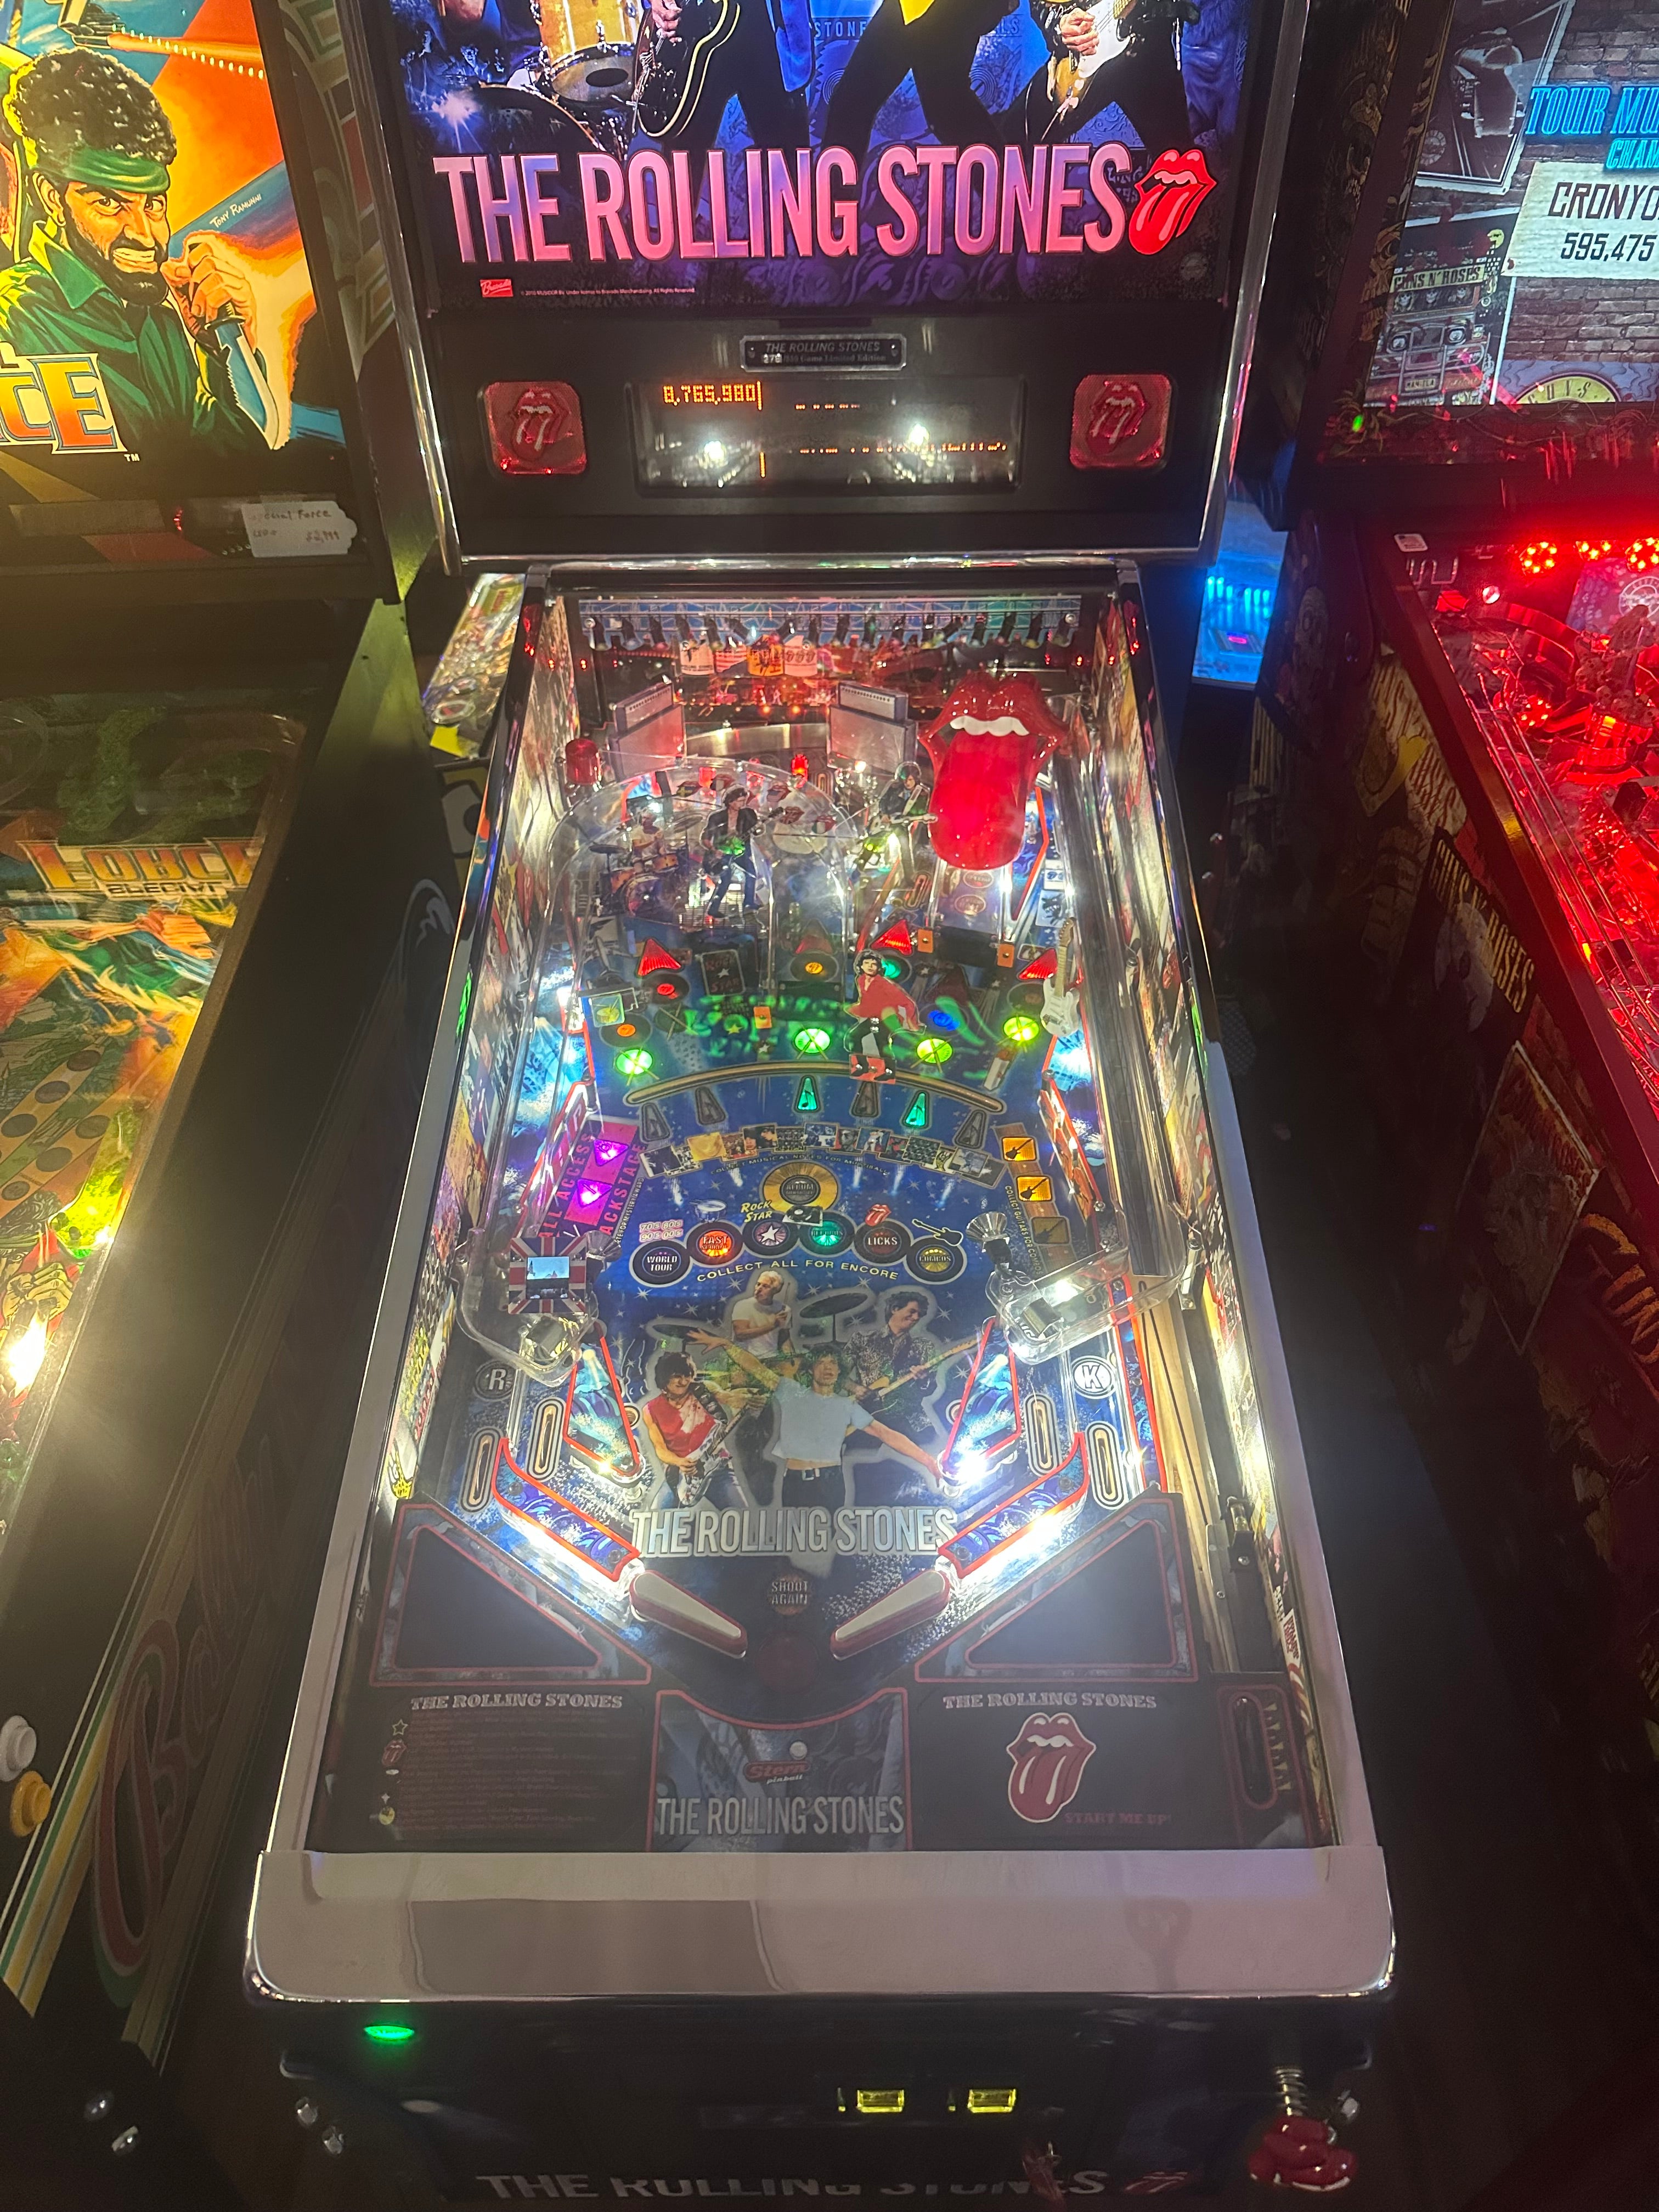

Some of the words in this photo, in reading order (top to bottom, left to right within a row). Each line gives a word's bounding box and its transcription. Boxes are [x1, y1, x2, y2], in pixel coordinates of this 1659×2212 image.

[1526, 86, 1611, 135] TOUR
[432, 155, 572, 263] THE
[578, 148, 860, 262] ROLLING
[876, 143, 1131, 256] STONES
[209, 210, 229, 228] TONY
[1560, 232, 1658, 262] 595,475
[1442, 267, 1481, 285] ROSES
[766, 342, 786, 353] THE
[789, 342, 835, 352] ROLLING
[838, 341, 881, 352] STONES
[124, 453, 140, 462] TM
[556, 1132, 593, 1201] ACCESS
[599, 1144, 647, 1236] ACKSTAGE
[741, 1200, 772, 1214] ROCK
[1005, 1184, 1019, 1210] COLLECT
[1014, 1211, 1029, 1235] GUITARS
[1023, 1237, 1033, 1248] FOR
[744, 1210, 773, 1223] STAR
[703, 1235, 729, 1244] FAST
[867, 1236, 898, 1246] LICKS
[646, 1255, 678, 1264] WORLD
[651, 1263, 673, 1272] TOUR
[697, 1261, 763, 1282] COLLECT
[770, 1260, 799, 1268] ALL
[805, 1260, 834, 1268] FOR
[840, 1262, 899, 1280] ENCORE
[487, 1368, 506, 1391] R
[1083, 1363, 1102, 1391] K
[632, 1510, 690, 1554] THE
[697, 1508, 827, 1553] ROLLING
[836, 1508, 956, 1553] STONES
[771, 1580, 809, 1593] SHOOT
[771, 1593, 809, 1605] AGAIN
[410, 1695, 449, 1710] THE
[452, 1693, 541, 1708] ROLLING
[545, 1694, 623, 1709] STONES
[943, 1695, 983, 1709] THE
[988, 1692, 1078, 1707] ROLLING
[1081, 1692, 1157, 1708] STONES
[746, 1761, 809, 1779] Stern
[766, 1773, 804, 1785] pinball
[657, 1797, 701, 1835] THE
[707, 1796, 807, 1835] ROLLING
[813, 1795, 905, 1835] STONES
[1063, 1812, 1116, 1825] START
[1118, 1813, 1143, 1825] ME
[475, 2174, 600, 2199] THE
